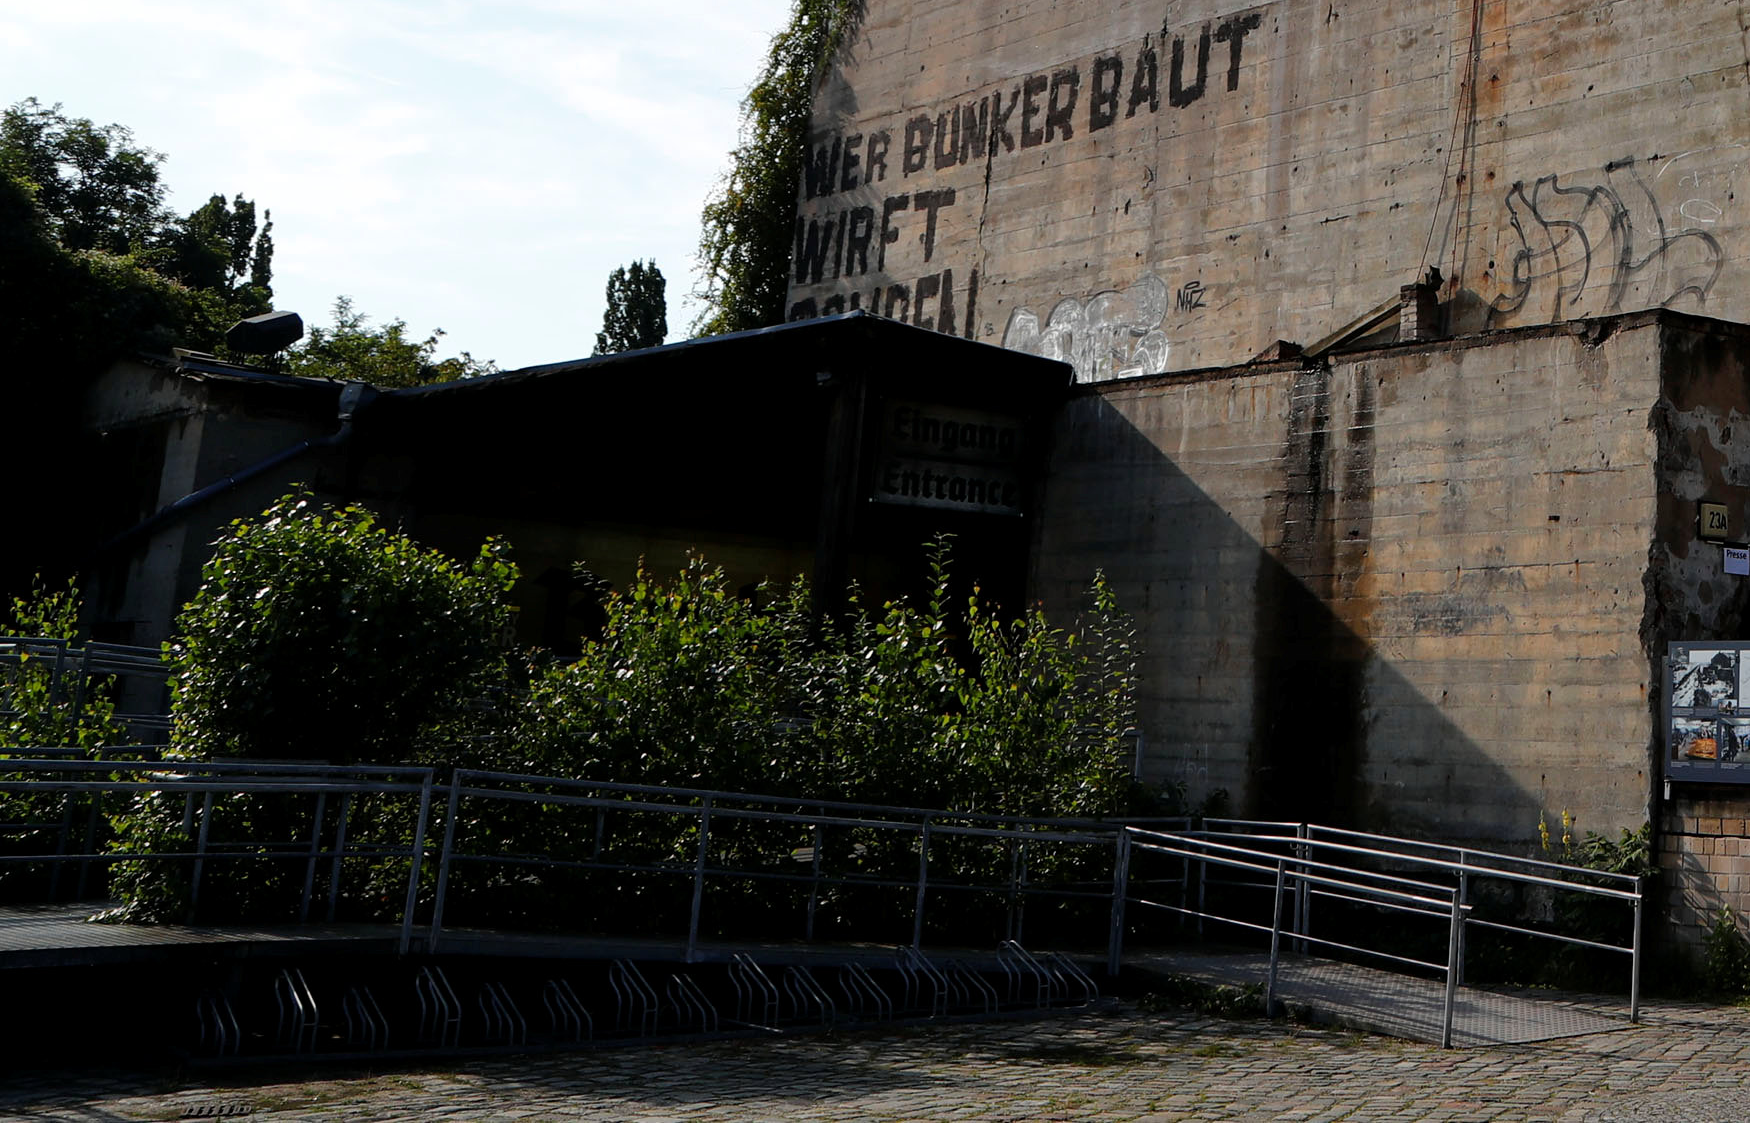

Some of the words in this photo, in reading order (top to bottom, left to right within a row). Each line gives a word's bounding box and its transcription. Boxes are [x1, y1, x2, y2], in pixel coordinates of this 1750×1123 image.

[803, 127, 891, 201] WER
[902, 64, 1080, 178] BUNKER
[1089, 11, 1262, 134] BAUT
[795, 188, 957, 285] WIRFT
[889, 406, 1016, 460] Eingang
[880, 462, 1018, 507] Entrance
[1709, 511, 1728, 530] 23A
[1726, 549, 1748, 560] Presse
